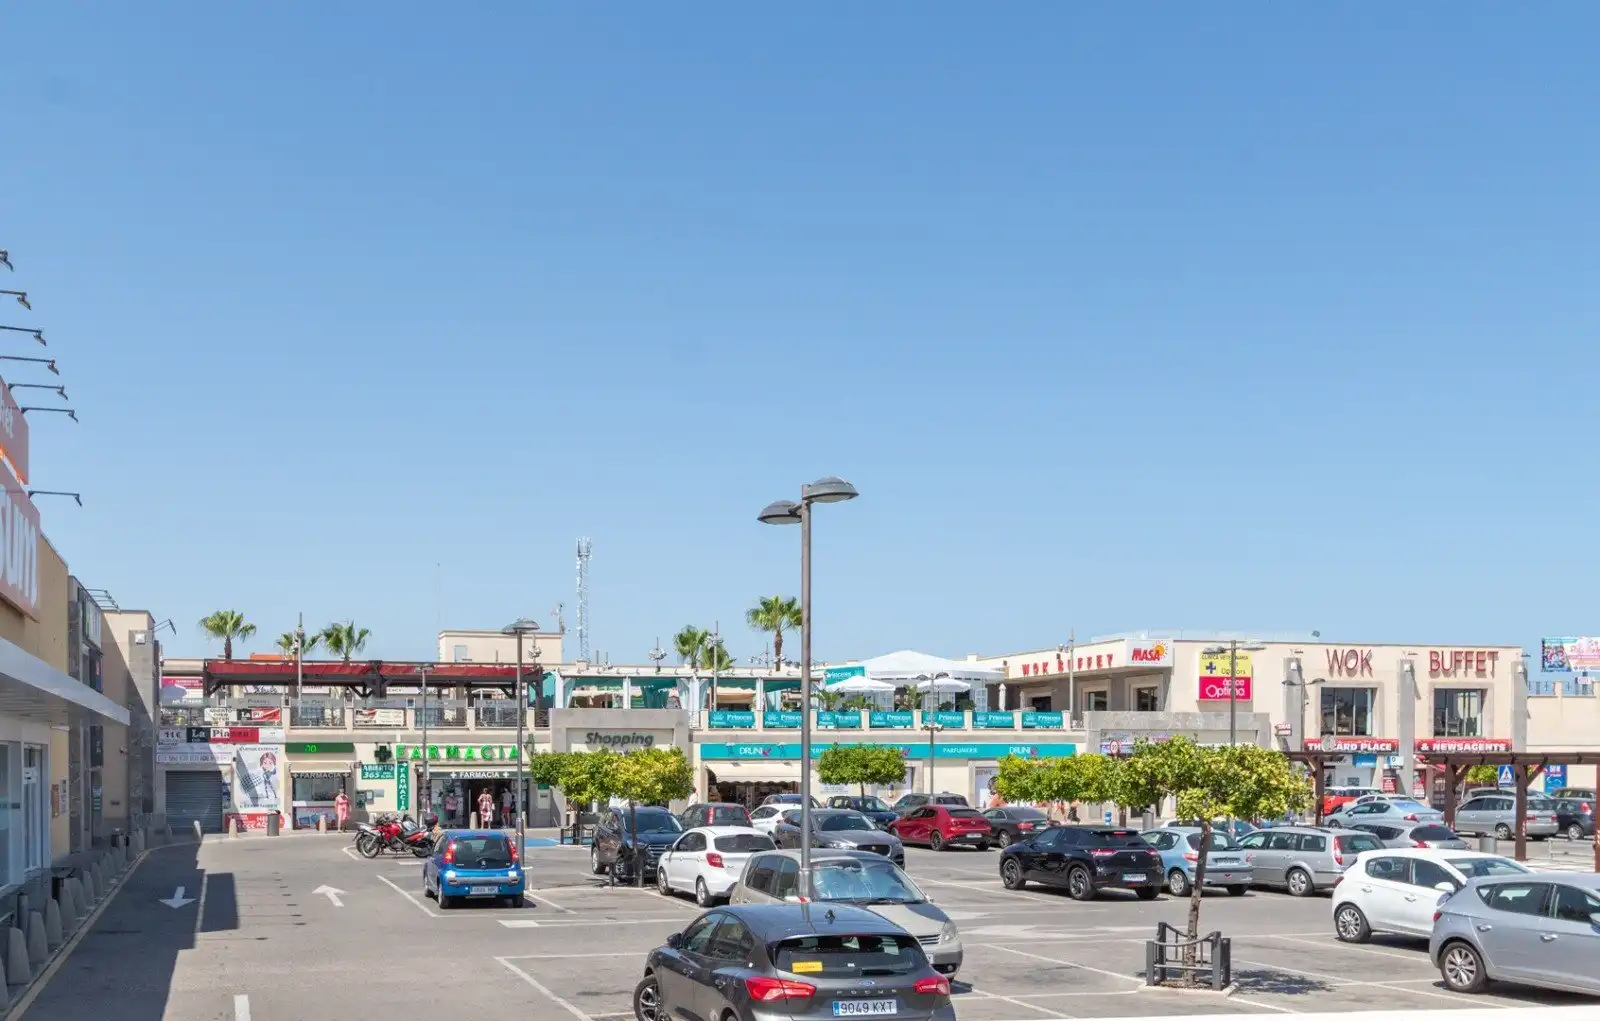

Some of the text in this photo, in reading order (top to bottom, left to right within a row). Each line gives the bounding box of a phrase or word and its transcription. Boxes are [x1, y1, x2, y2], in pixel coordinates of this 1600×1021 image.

[1131, 647, 1161, 662] MASA
[1325, 649, 1499, 673] WOK BUFFET
[1022, 662, 1049, 676] WOK
[1222, 678, 1245, 687] ópca
[191, 729, 206, 738] La
[585, 732, 654, 747] Shopping
[396, 744, 519, 760] FARMACIA
[1307, 743, 1321, 751] TH
[1360, 743, 1392, 751] PLACE
[1421, 743, 1506, 751] & NEWSAGENTS
[364, 771, 380, 779] 365
[460, 771, 500, 779] FARMACIA
[841, 1001, 894, 1014] 9049 KXT
